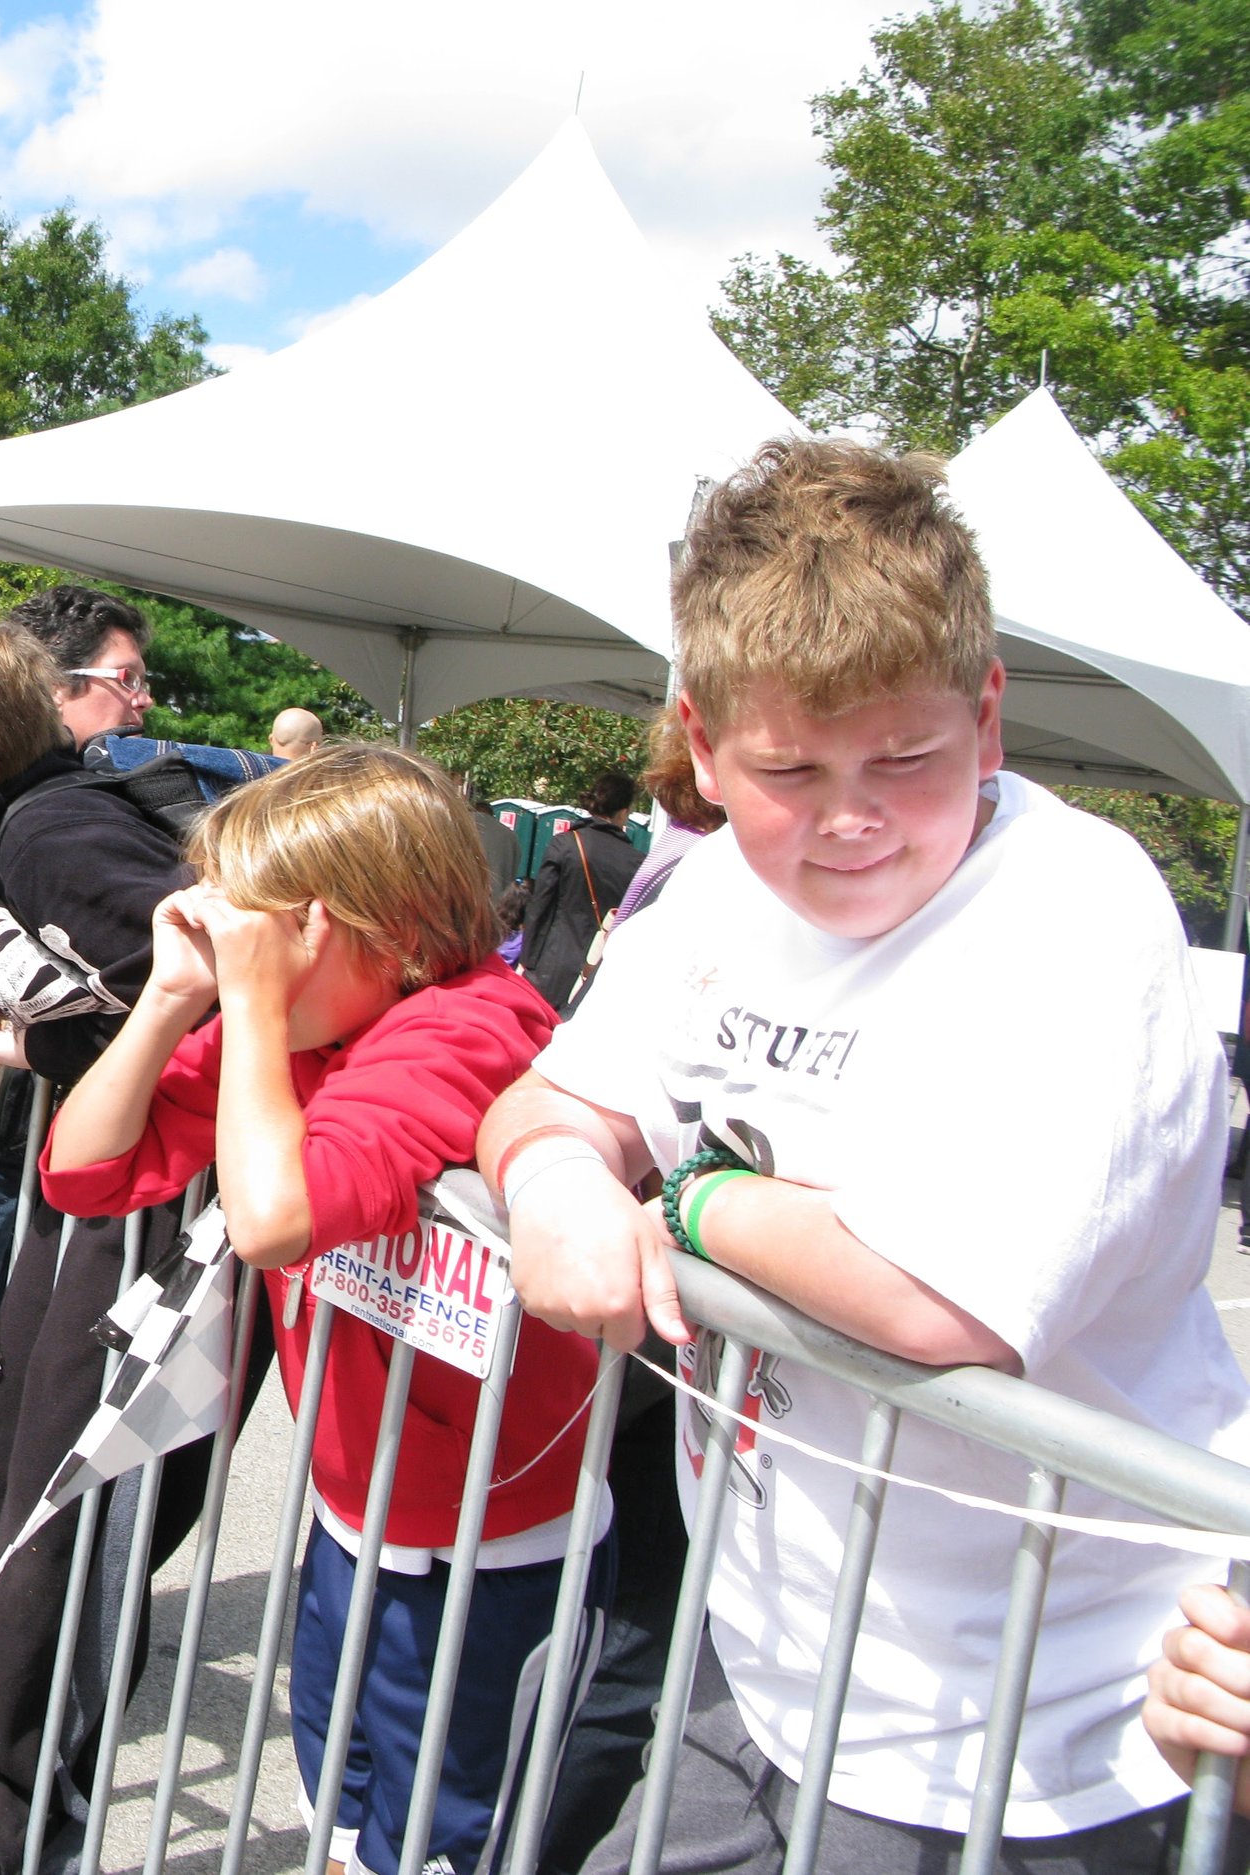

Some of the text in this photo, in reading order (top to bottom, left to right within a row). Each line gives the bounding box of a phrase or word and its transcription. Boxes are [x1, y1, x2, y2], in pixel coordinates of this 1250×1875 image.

[319, 1266, 485, 1358] 1-800-352-5675
[321, 1251, 489, 1338] RENT-A-FENCE
[339, 1221, 493, 1314] IONAL
